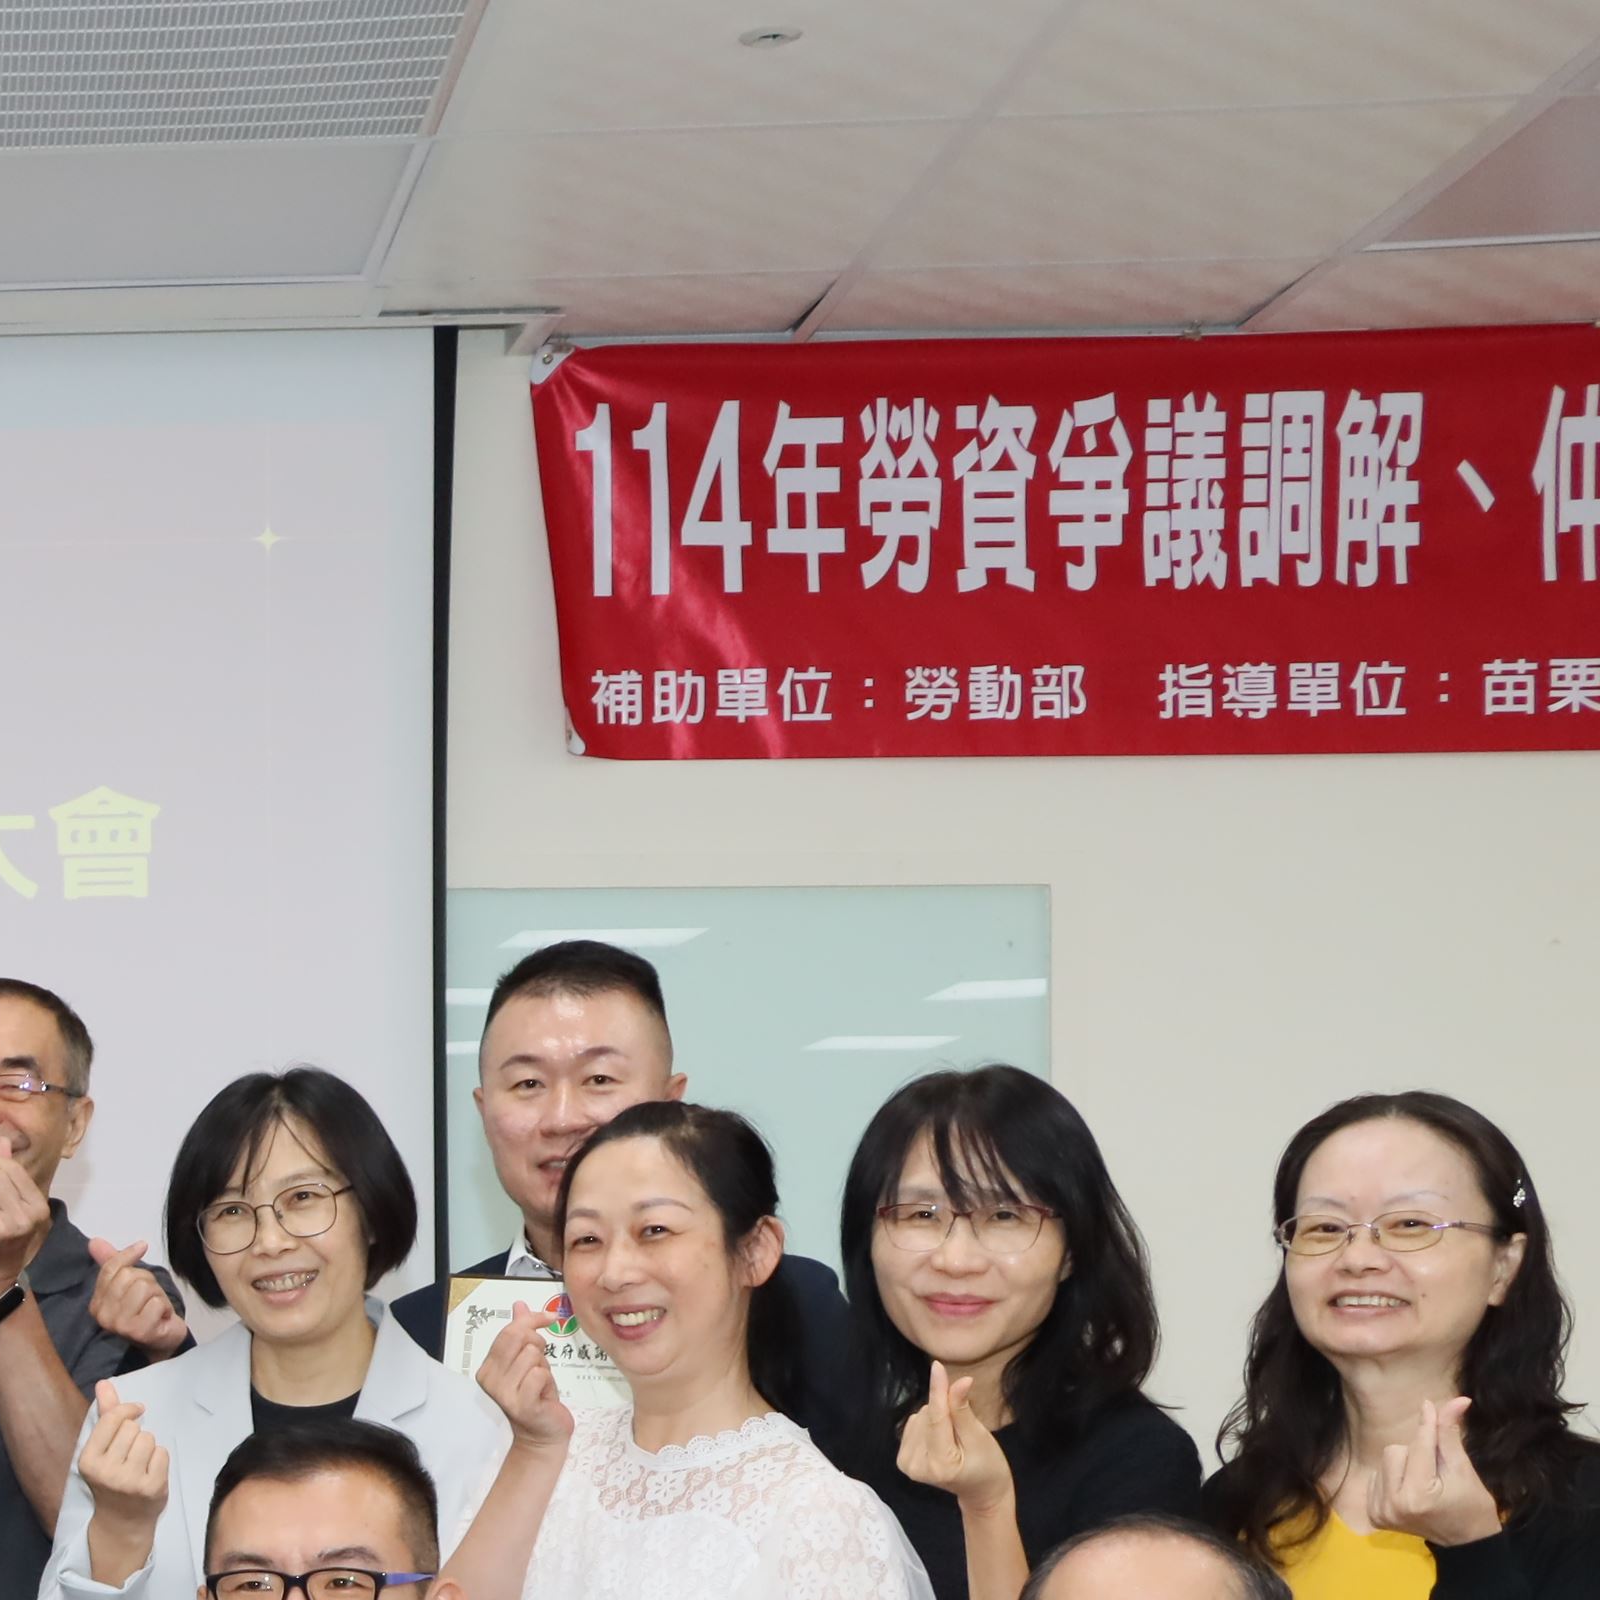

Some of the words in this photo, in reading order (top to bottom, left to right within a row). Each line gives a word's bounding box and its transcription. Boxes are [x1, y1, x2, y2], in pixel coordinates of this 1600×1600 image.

[574, 385, 1600, 597] 114年勞資爭議調解、仲
[591, 665, 1088, 727] 補助單位：勞動部
[1158, 658, 1600, 719] 指導單位：苗栗
